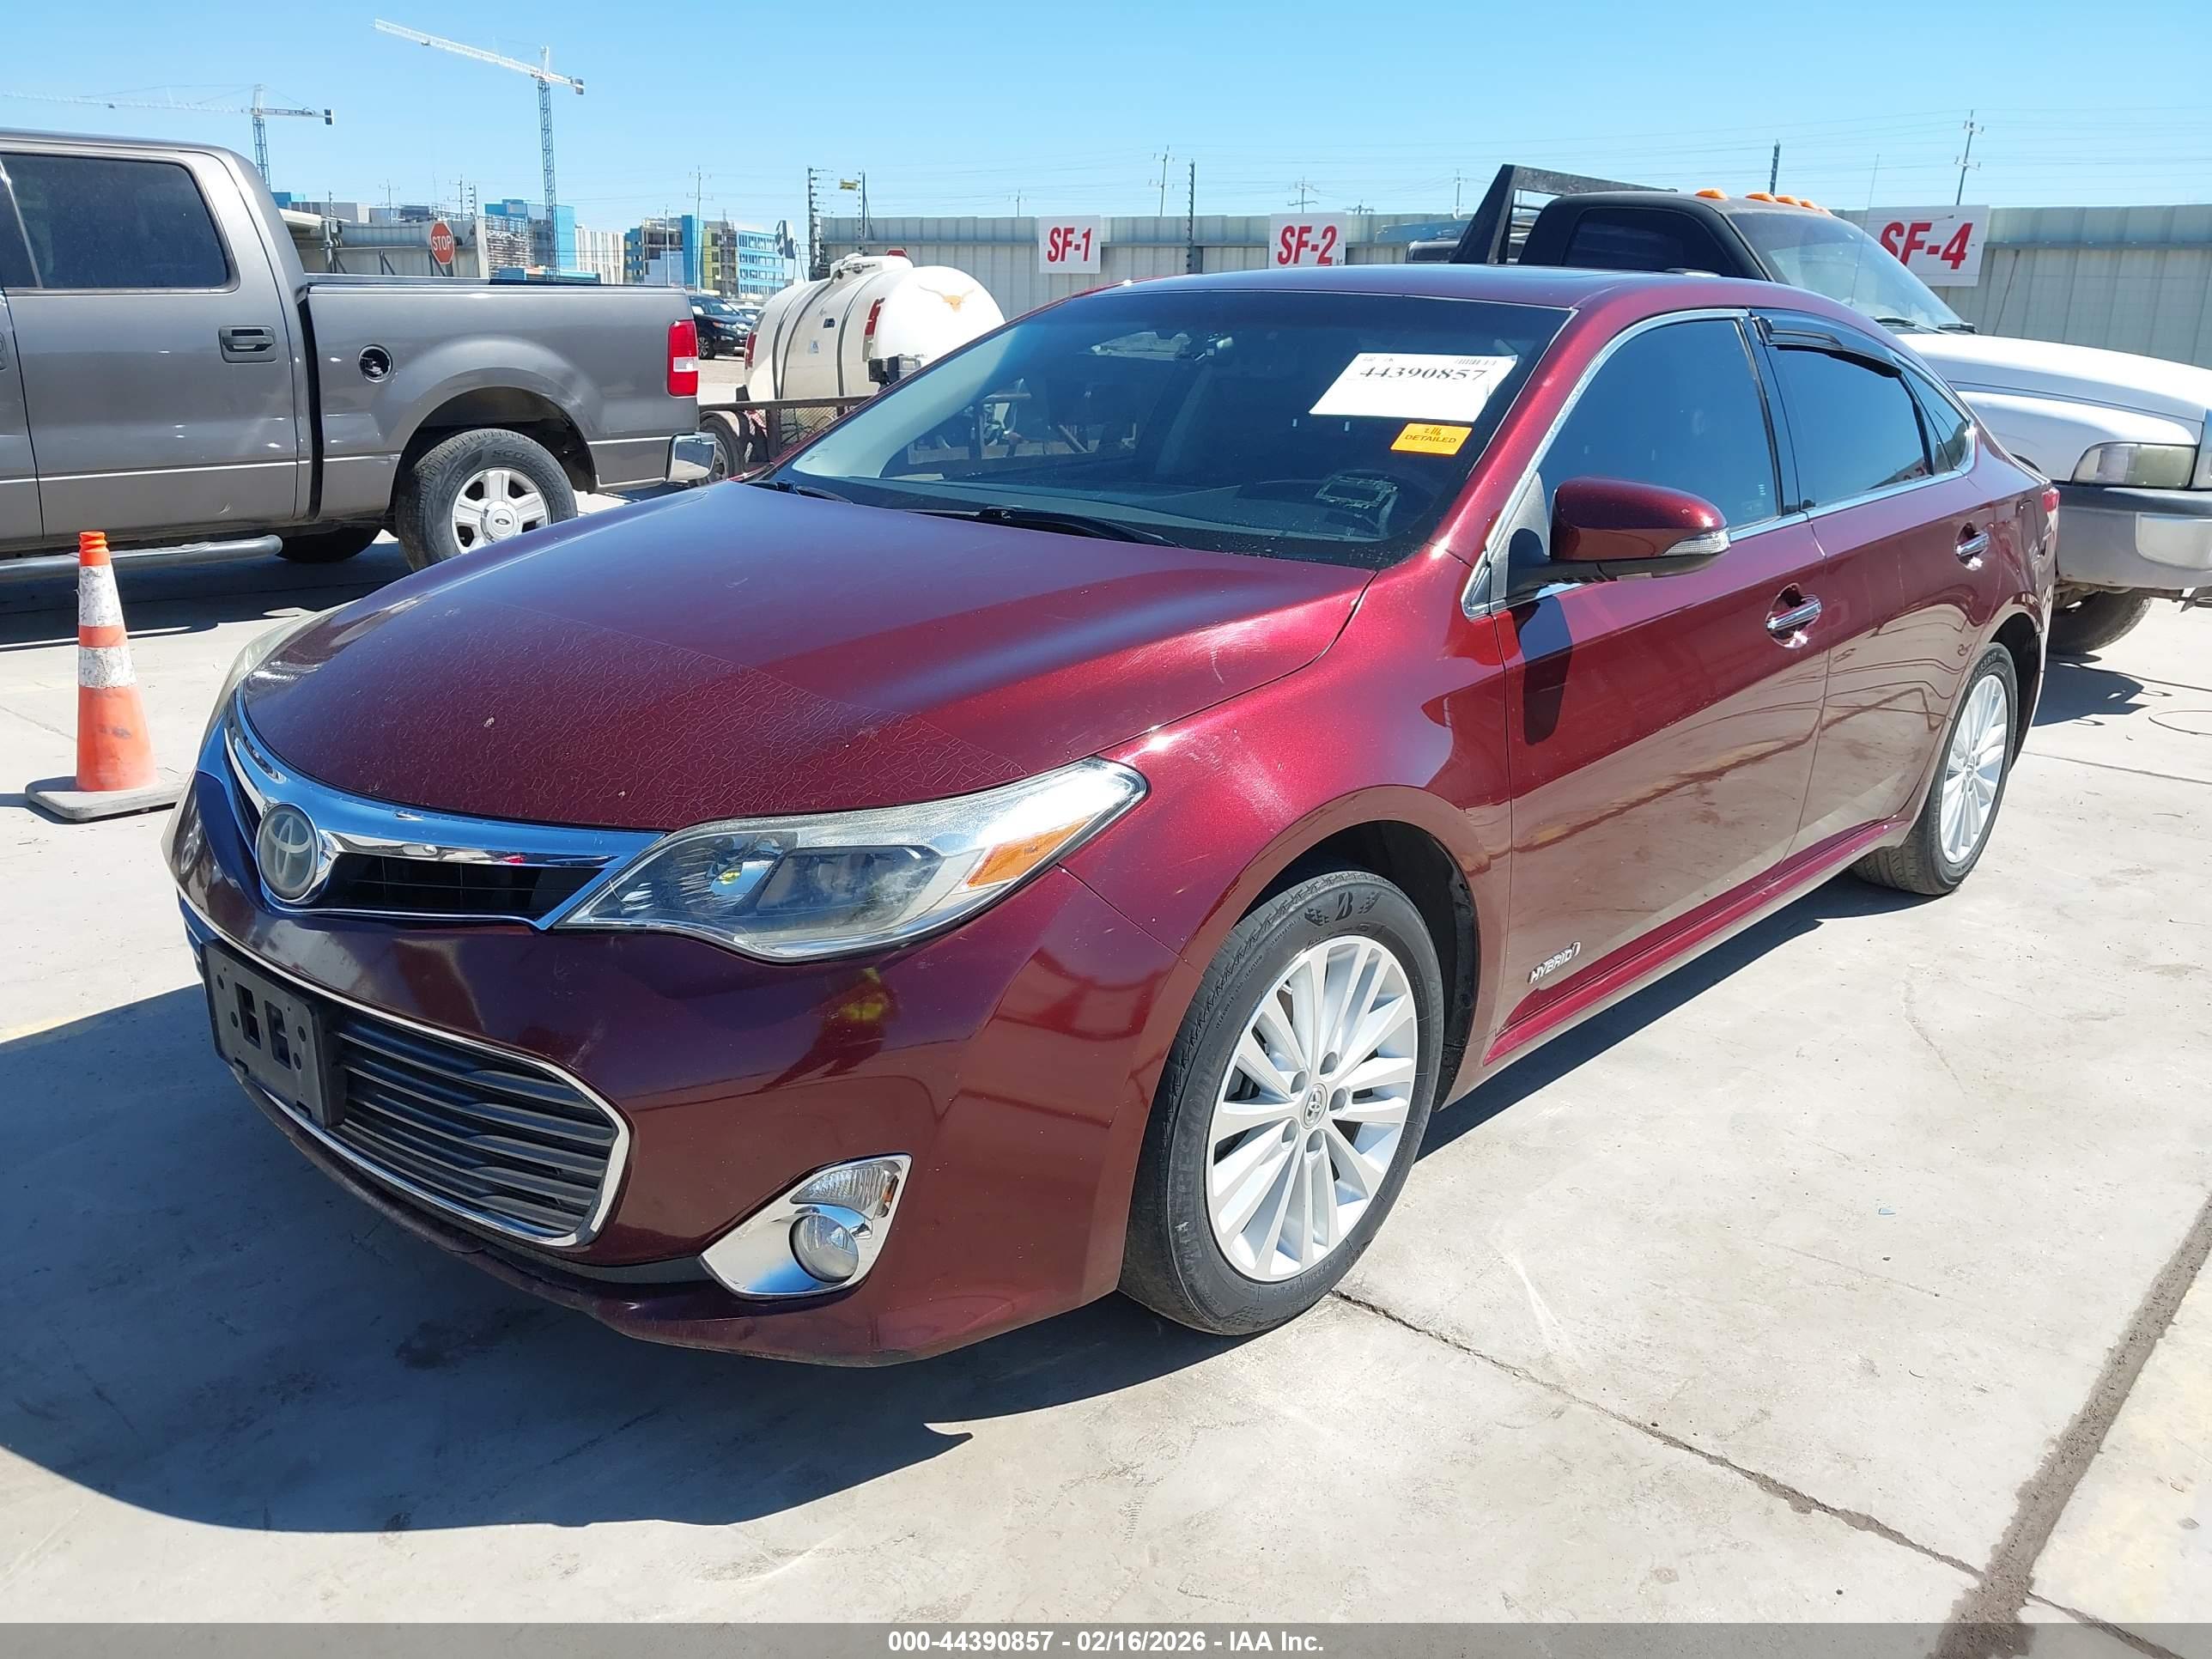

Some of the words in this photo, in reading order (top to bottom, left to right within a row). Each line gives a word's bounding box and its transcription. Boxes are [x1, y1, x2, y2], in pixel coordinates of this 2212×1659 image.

[432, 235, 452, 252] STOP
[1047, 226, 1092, 263] SF-1
[1277, 225, 1337, 266] SF-2
[1880, 221, 1974, 270] SF-4
[1359, 367, 1488, 380] 44390857
[1404, 434, 1457, 444] DETAILED
[1528, 948, 1573, 985] HYBRID
